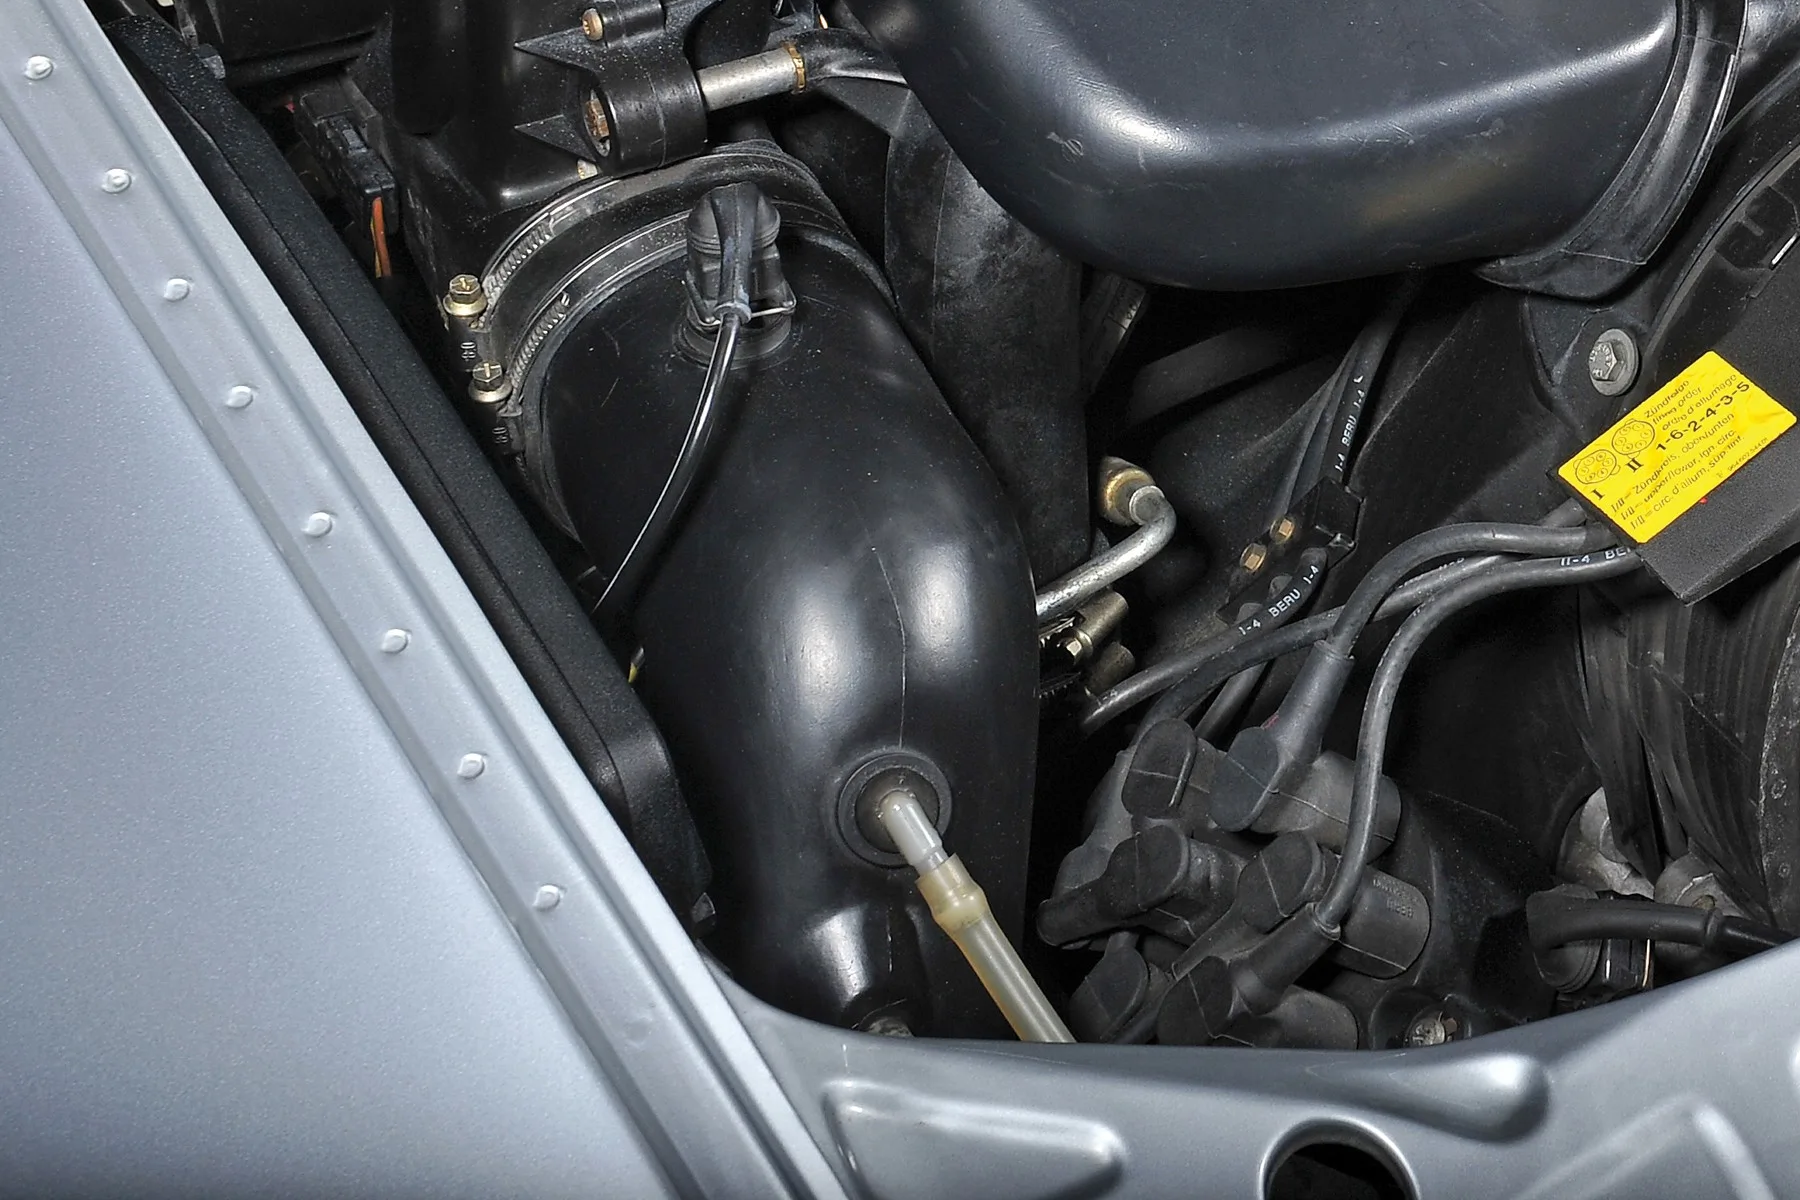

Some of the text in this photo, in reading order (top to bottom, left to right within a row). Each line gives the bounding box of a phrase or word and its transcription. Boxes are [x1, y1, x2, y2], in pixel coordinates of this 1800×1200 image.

[1677, 387, 1700, 406] order
[1656, 381, 1749, 449] 1-6-2-4-3-5
[1661, 414, 1687, 430] ordre
[1267, 586, 1302, 618] BERU
